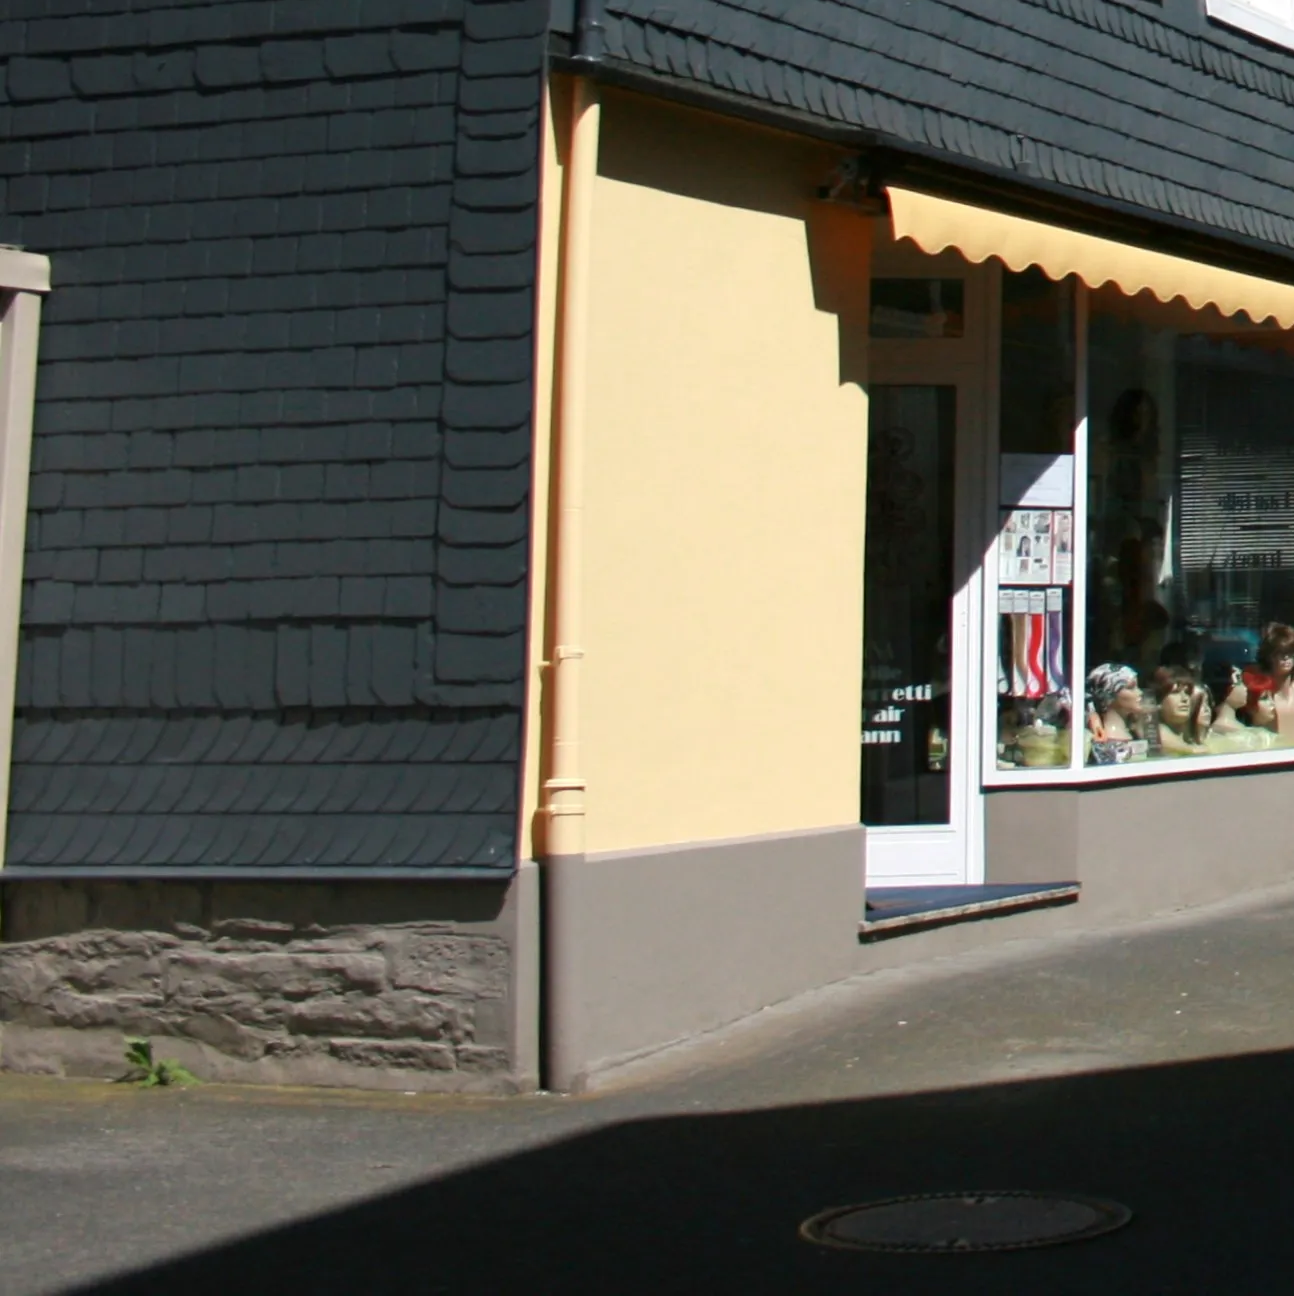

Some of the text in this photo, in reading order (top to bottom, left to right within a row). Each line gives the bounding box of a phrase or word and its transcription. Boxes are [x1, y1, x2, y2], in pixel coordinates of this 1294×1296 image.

[892, 684, 931, 701] etti
[873, 706, 905, 722] air
[861, 730, 901, 743] ann
